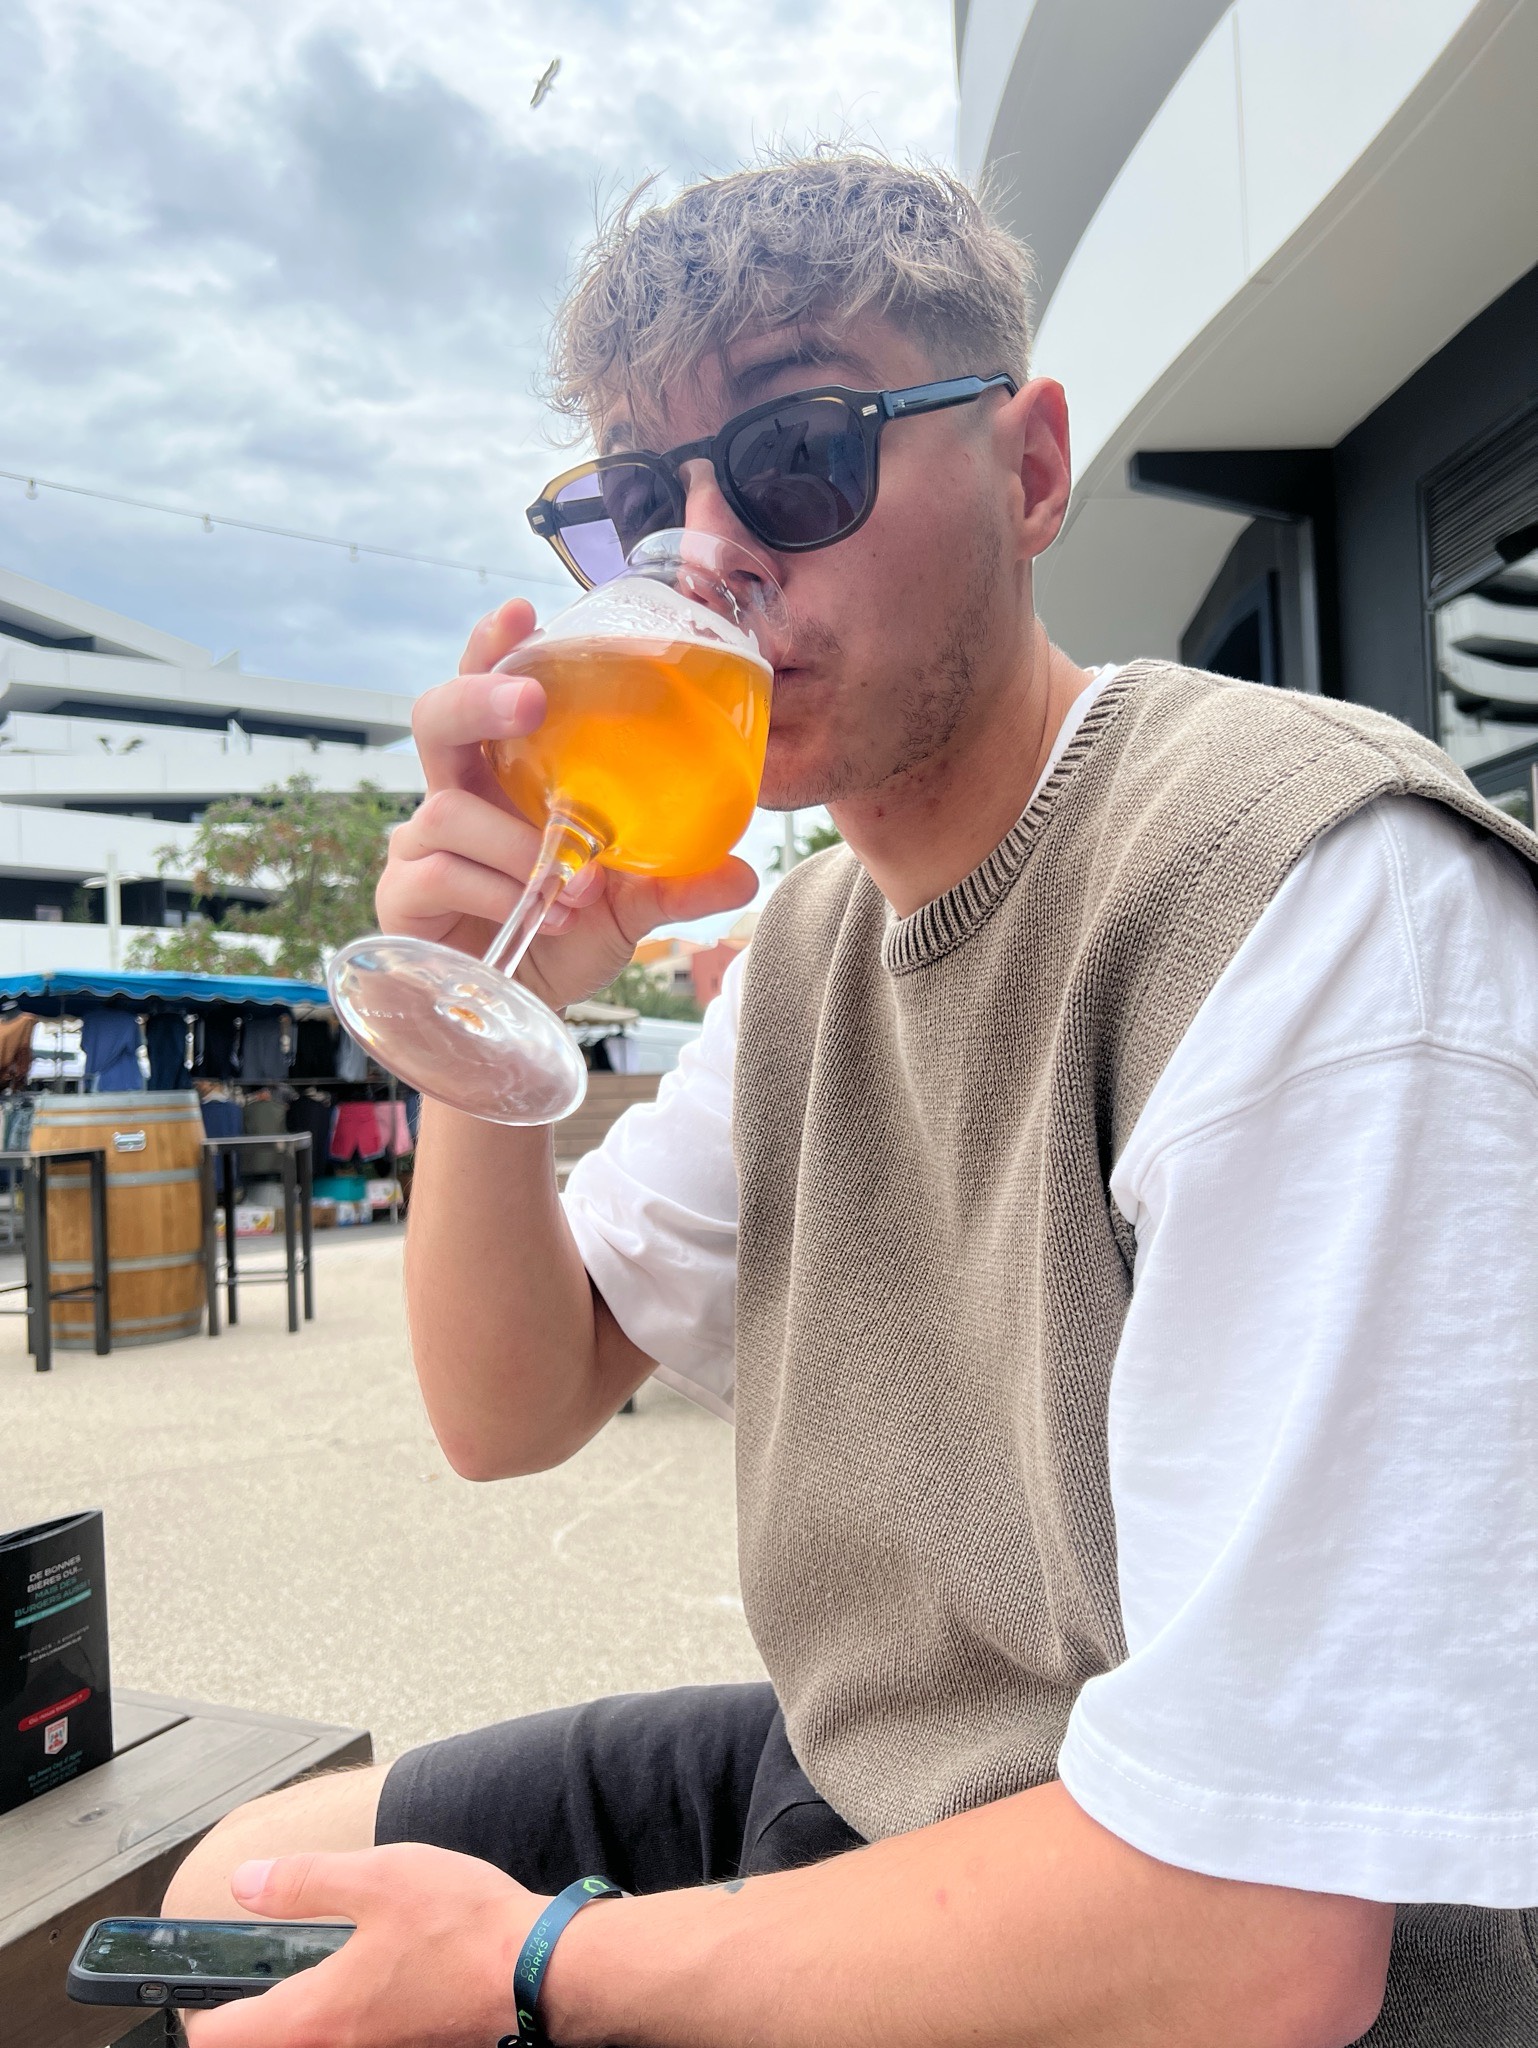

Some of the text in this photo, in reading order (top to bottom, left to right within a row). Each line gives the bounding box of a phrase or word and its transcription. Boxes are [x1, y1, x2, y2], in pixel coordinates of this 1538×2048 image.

[29, 1554, 81, 1582] DE BONNES
[35, 1575, 77, 1600] MAIS DES
[14, 1593, 62, 1618] BURGERS
[521, 1918, 552, 1978] COTTAGE
[527, 1941, 549, 1983] PARKS
